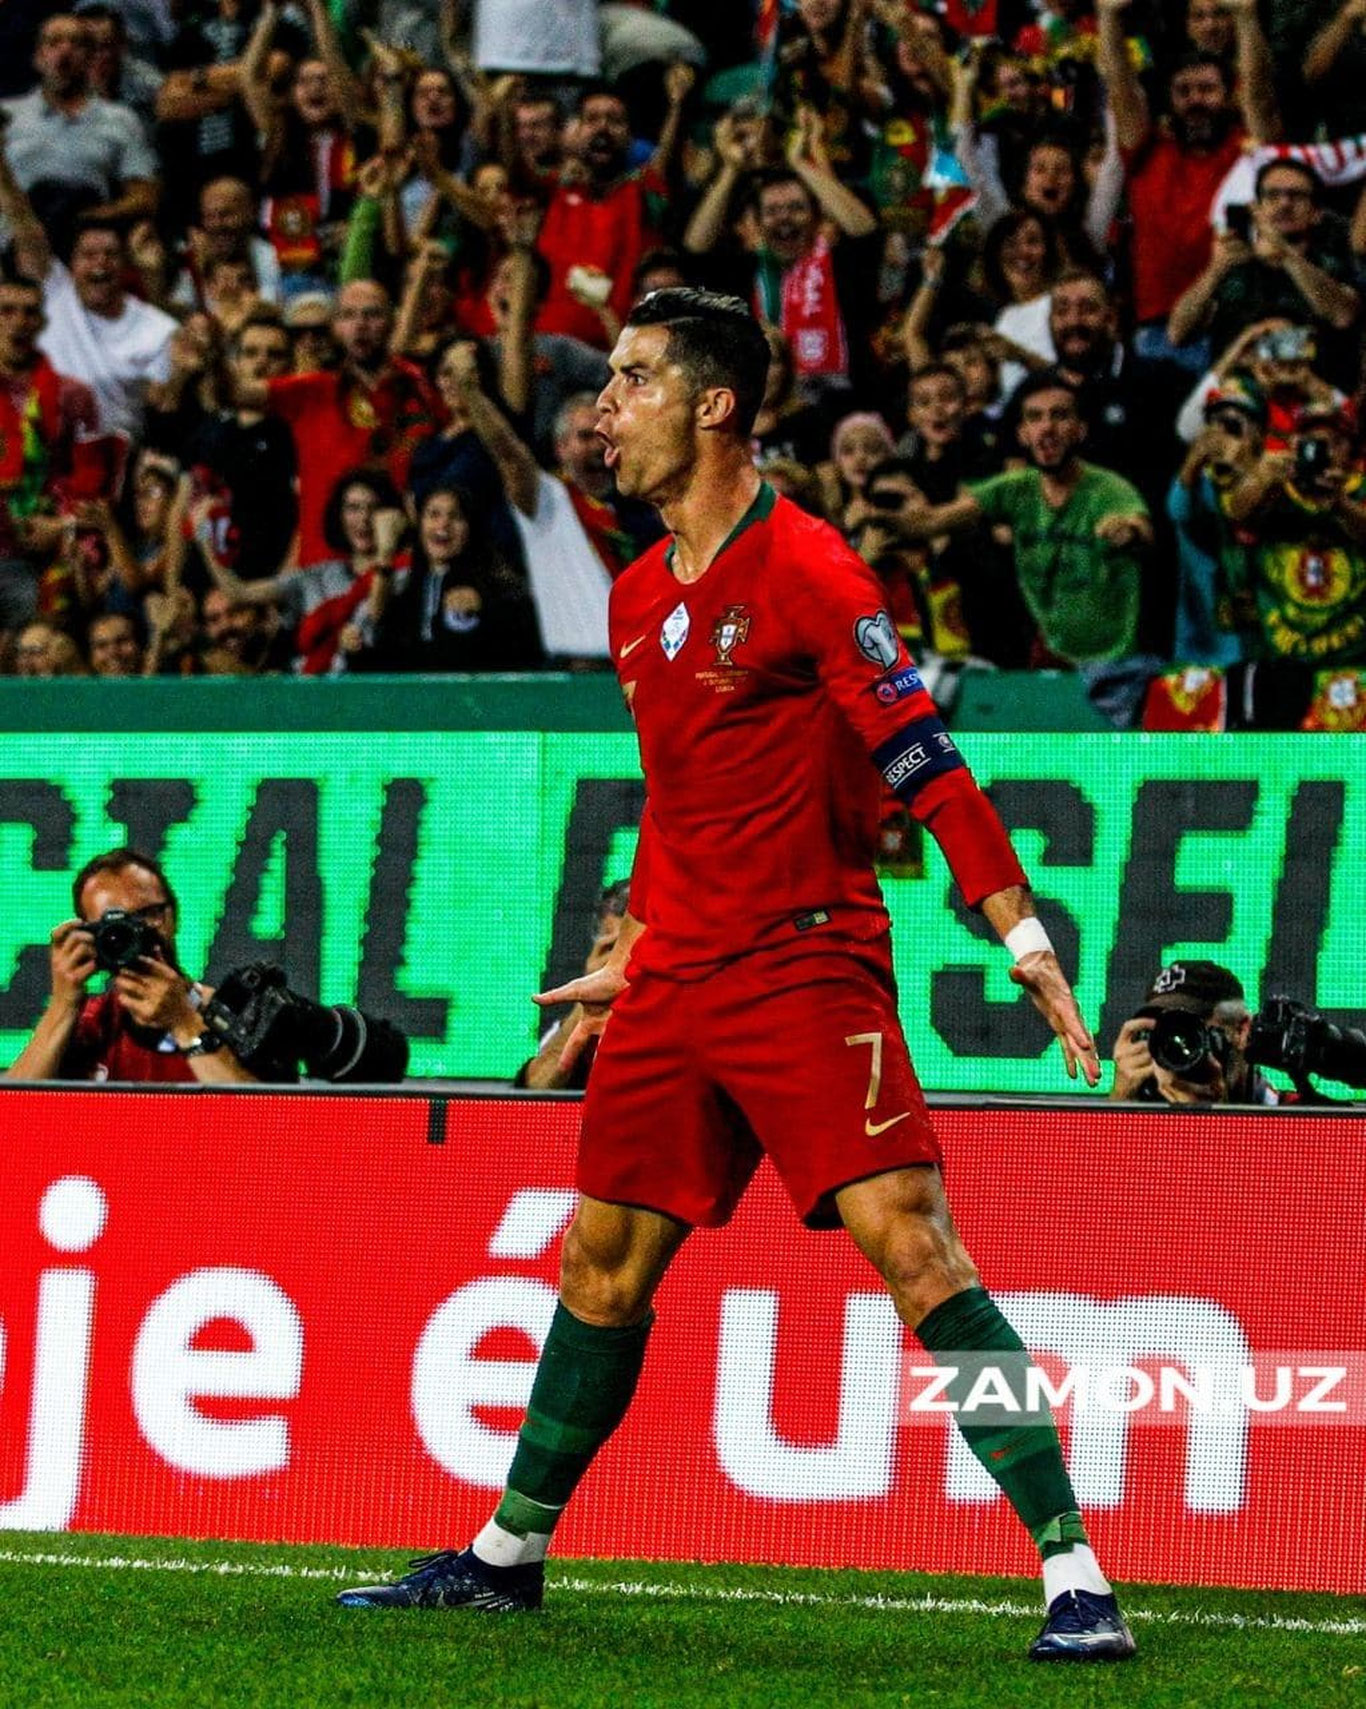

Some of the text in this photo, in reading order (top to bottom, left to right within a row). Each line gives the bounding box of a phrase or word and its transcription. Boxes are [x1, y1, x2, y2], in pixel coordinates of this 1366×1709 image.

[895, 673, 920, 691] RES
[845, 1032, 882, 1110] 7
[0, 1175, 1252, 1531] je é um
